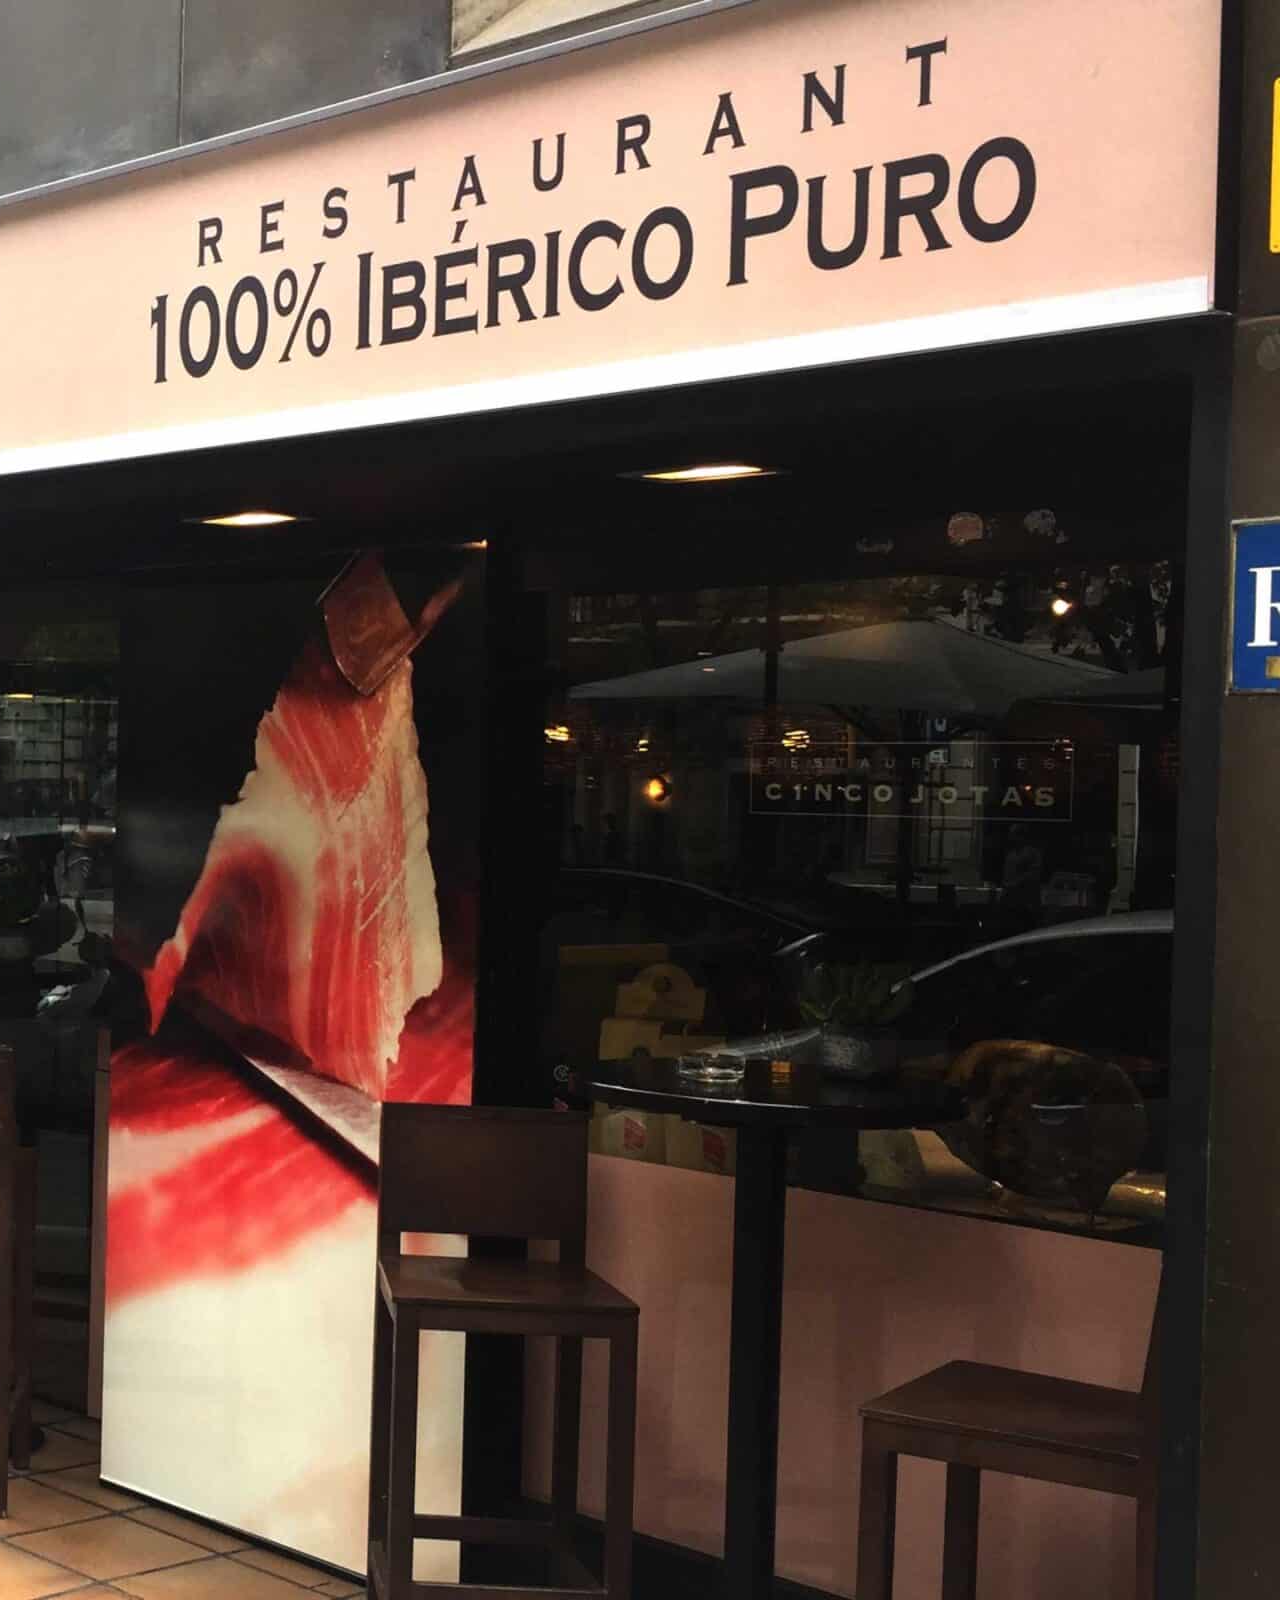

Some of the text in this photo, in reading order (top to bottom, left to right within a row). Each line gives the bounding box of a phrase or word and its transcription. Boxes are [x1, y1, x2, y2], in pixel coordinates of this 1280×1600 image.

[150, 136, 1038, 384] 100% IBÉRICO PURO
[197, 36, 948, 267] RESTAURANT
